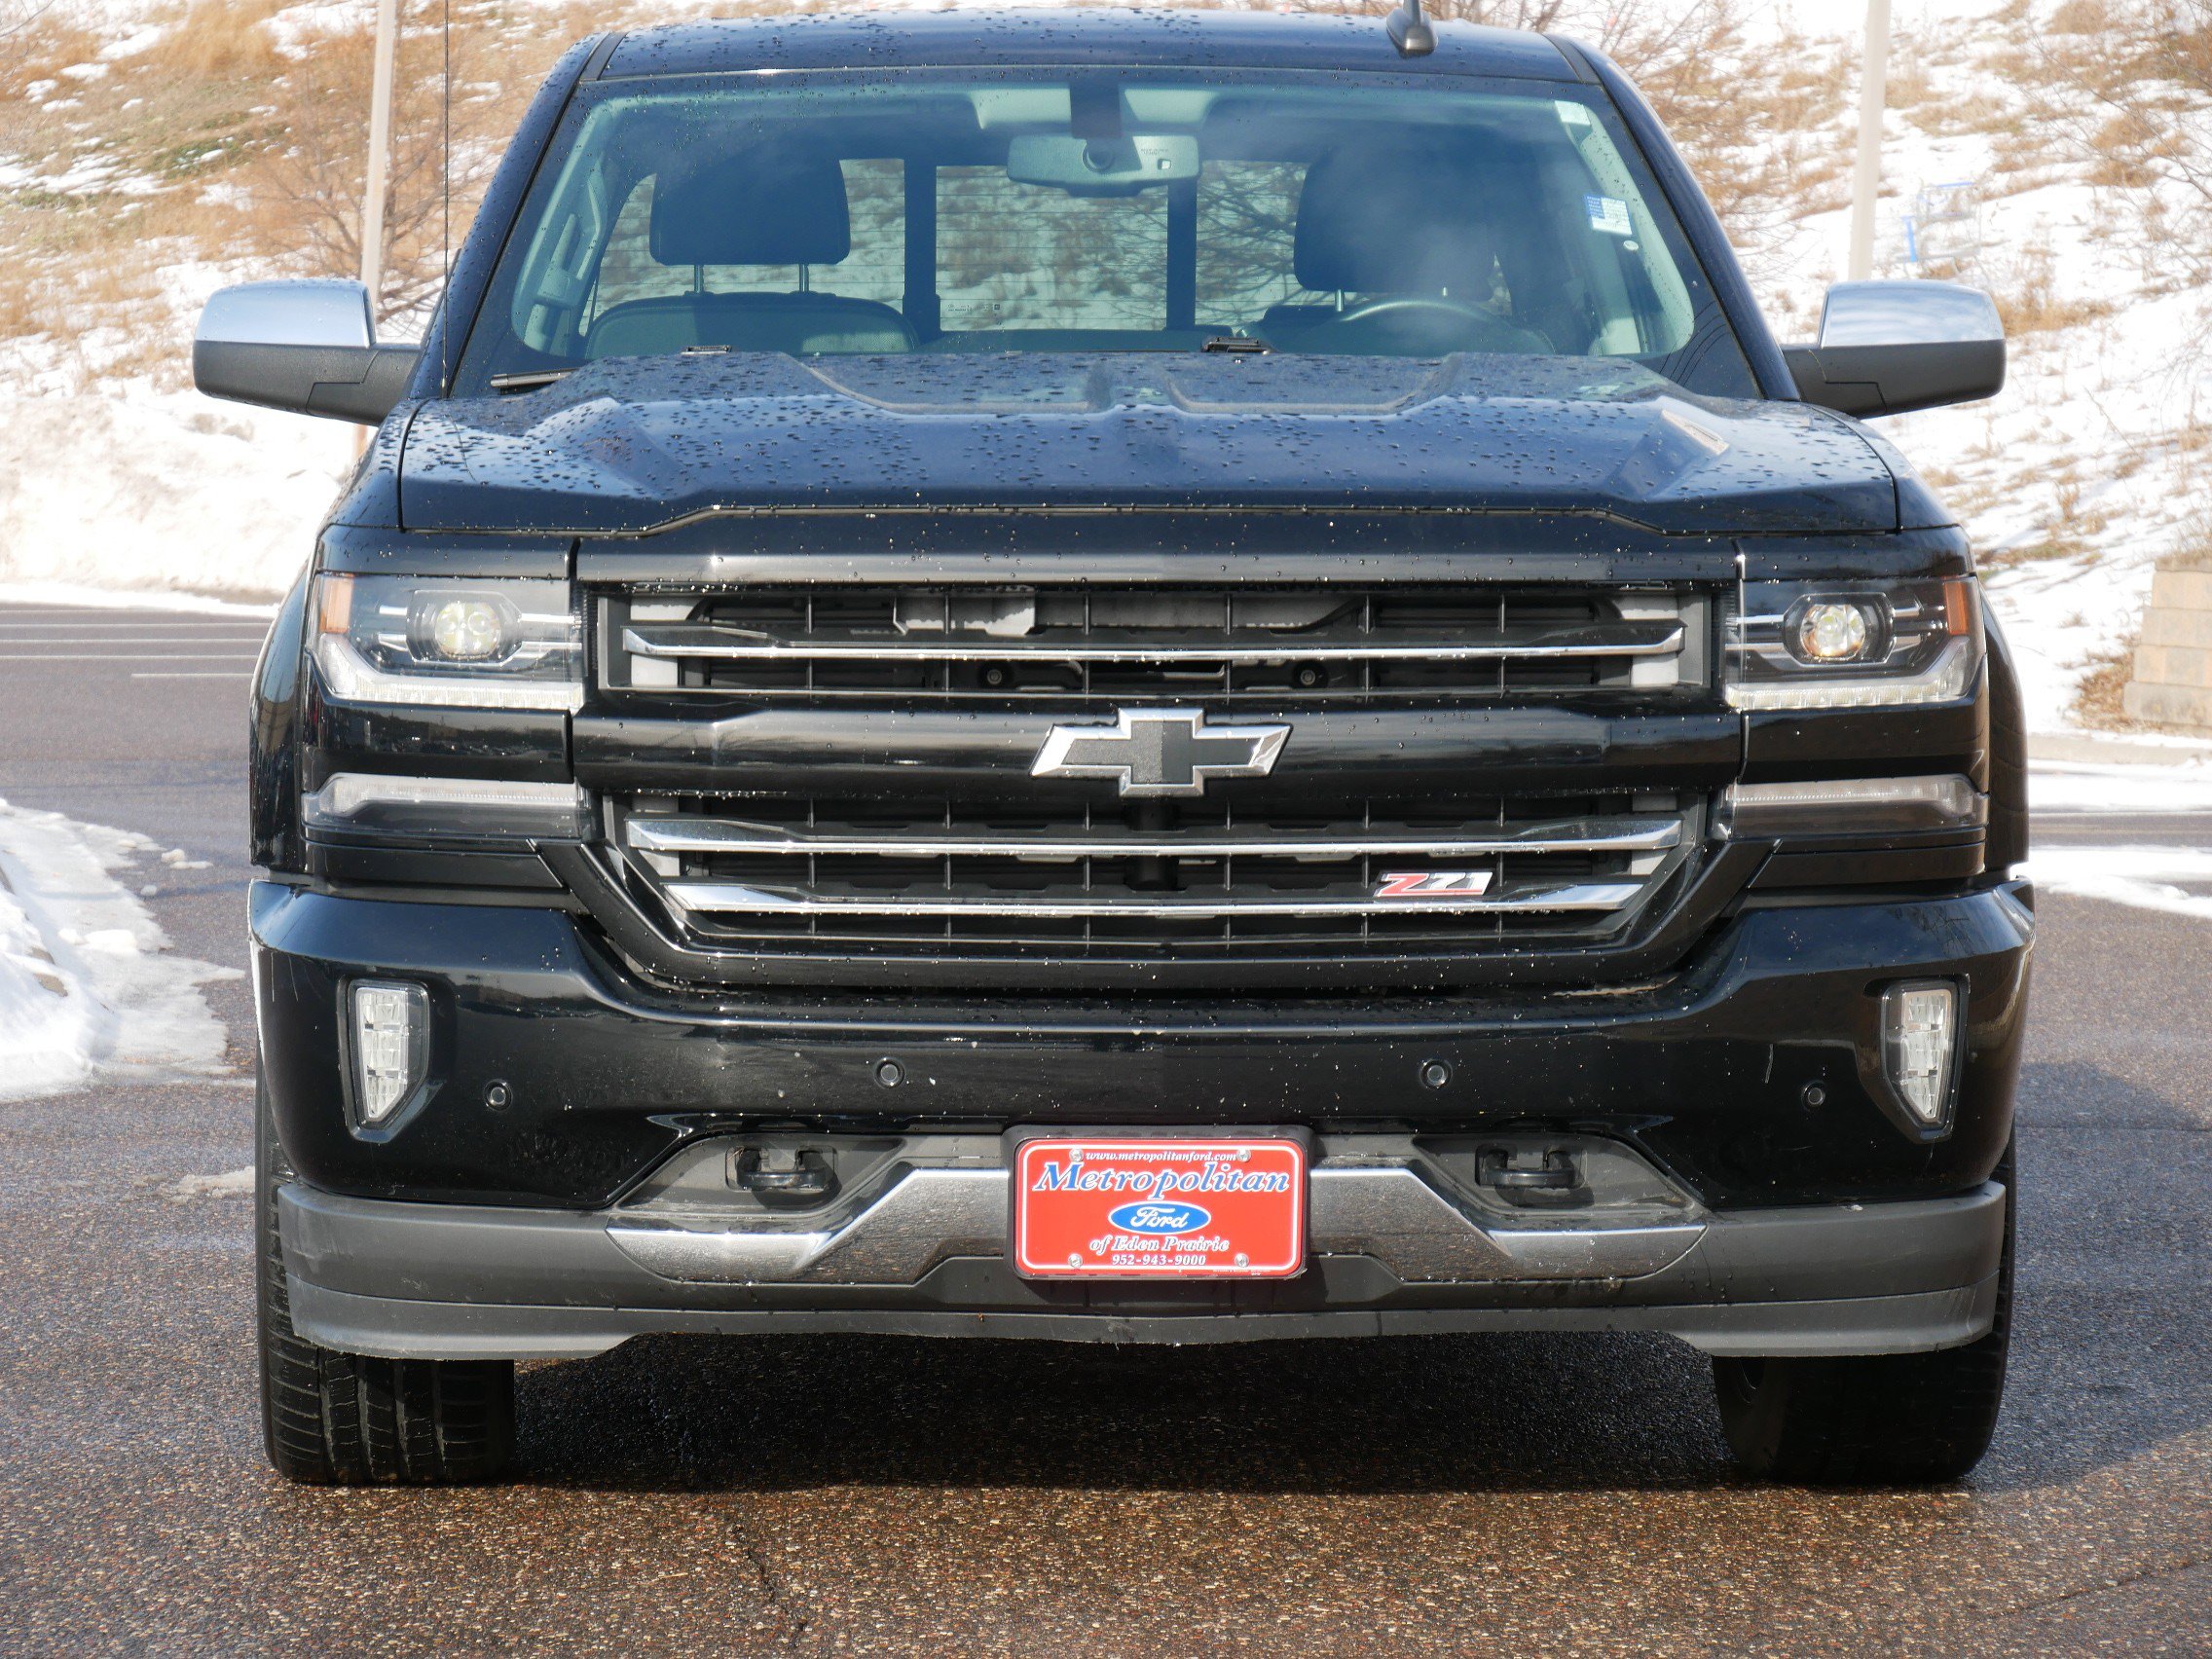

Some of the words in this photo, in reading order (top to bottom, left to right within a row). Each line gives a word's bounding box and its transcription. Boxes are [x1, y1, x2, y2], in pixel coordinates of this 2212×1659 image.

[1375, 871, 1493, 897] Z71
[1086, 1151, 1236, 1162] www.metropolitanford.com
[1032, 1161, 1290, 1200] Metropolitan
[1129, 1206, 1190, 1228] Ford
[1088, 1235, 1113, 1256] of
[1111, 1235, 1160, 1251] Eden
[1161, 1235, 1230, 1252] Prairie
[1112, 1254, 1206, 1266] 952-943-9000
